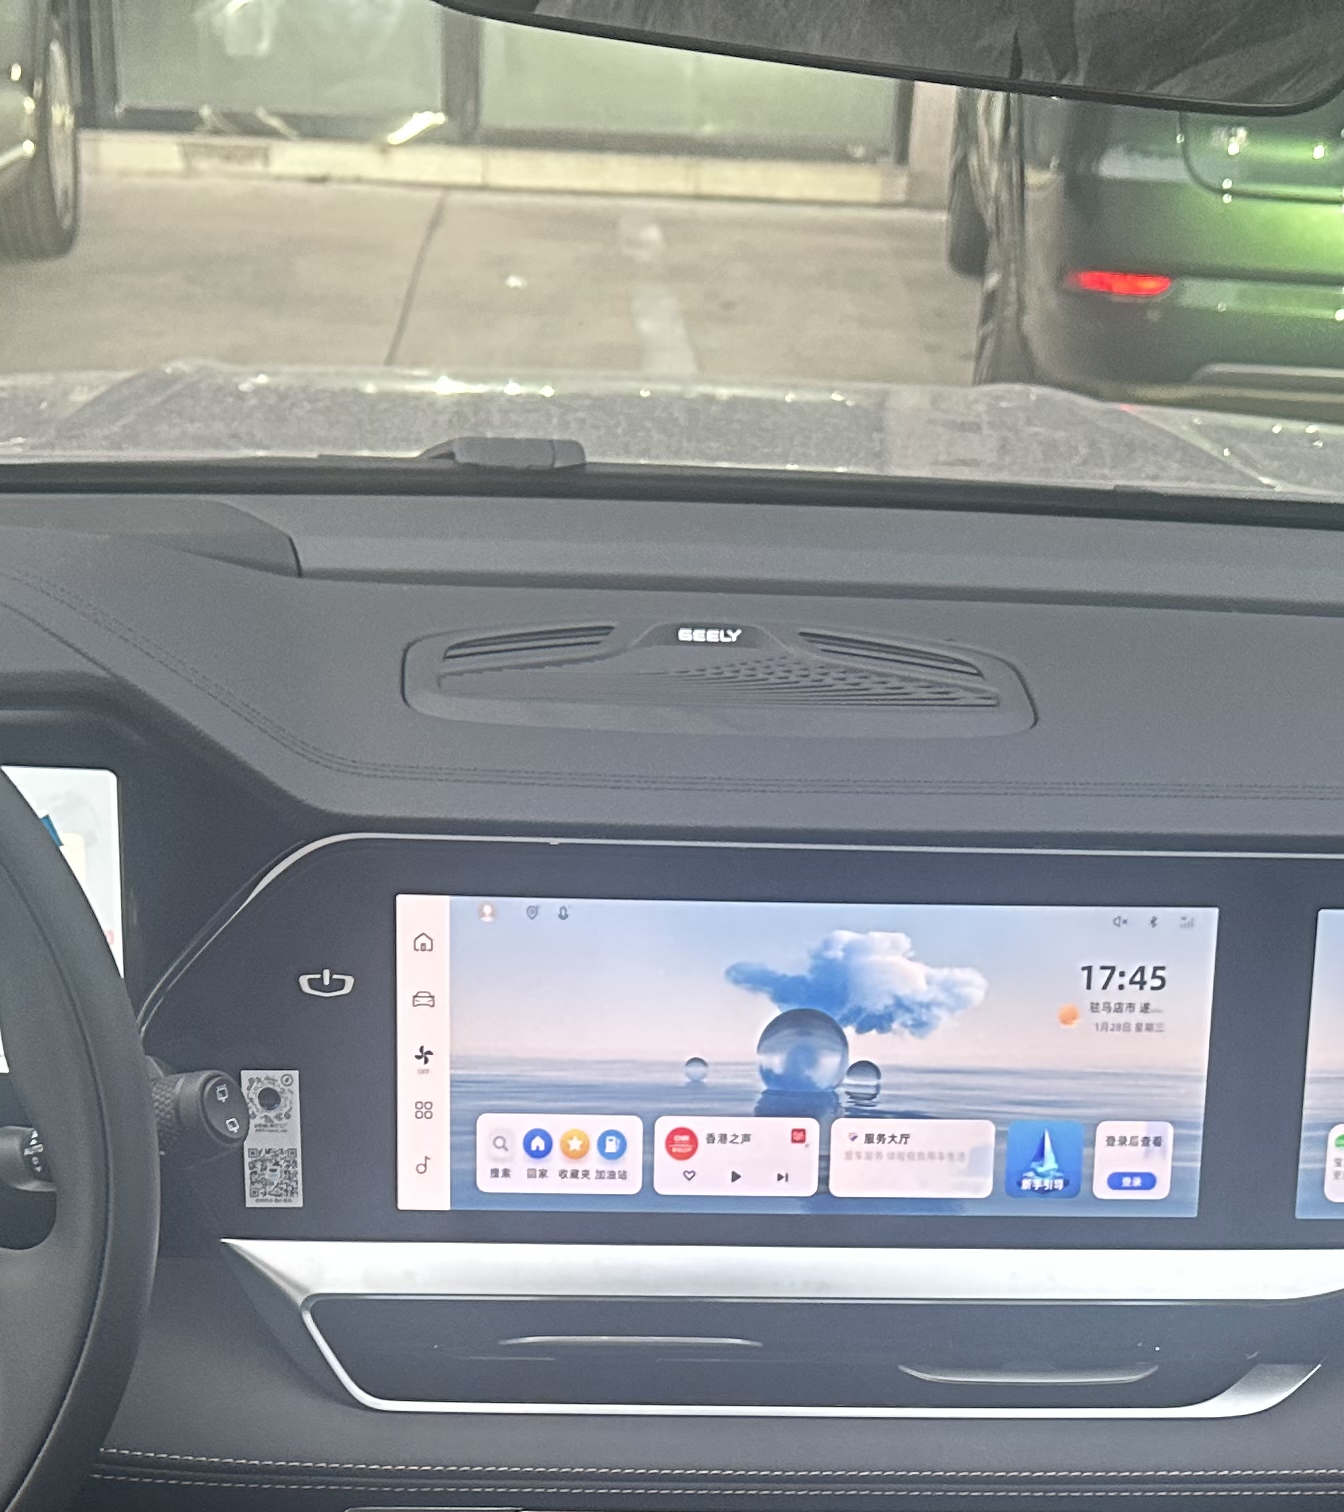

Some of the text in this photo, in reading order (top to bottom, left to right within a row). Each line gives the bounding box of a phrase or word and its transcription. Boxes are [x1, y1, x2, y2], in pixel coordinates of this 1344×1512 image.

[677, 627, 742, 643] GEELY
[1080, 965, 1167, 991] 17:45
[705, 1132, 752, 1145] 香港之声
[863, 1132, 911, 1145] 服务大厅
[489, 1167, 511, 1179] 搜索
[526, 1167, 549, 1179] 回家
[558, 1168, 591, 1180] 收藏夹
[595, 1169, 628, 1181] 加油站
